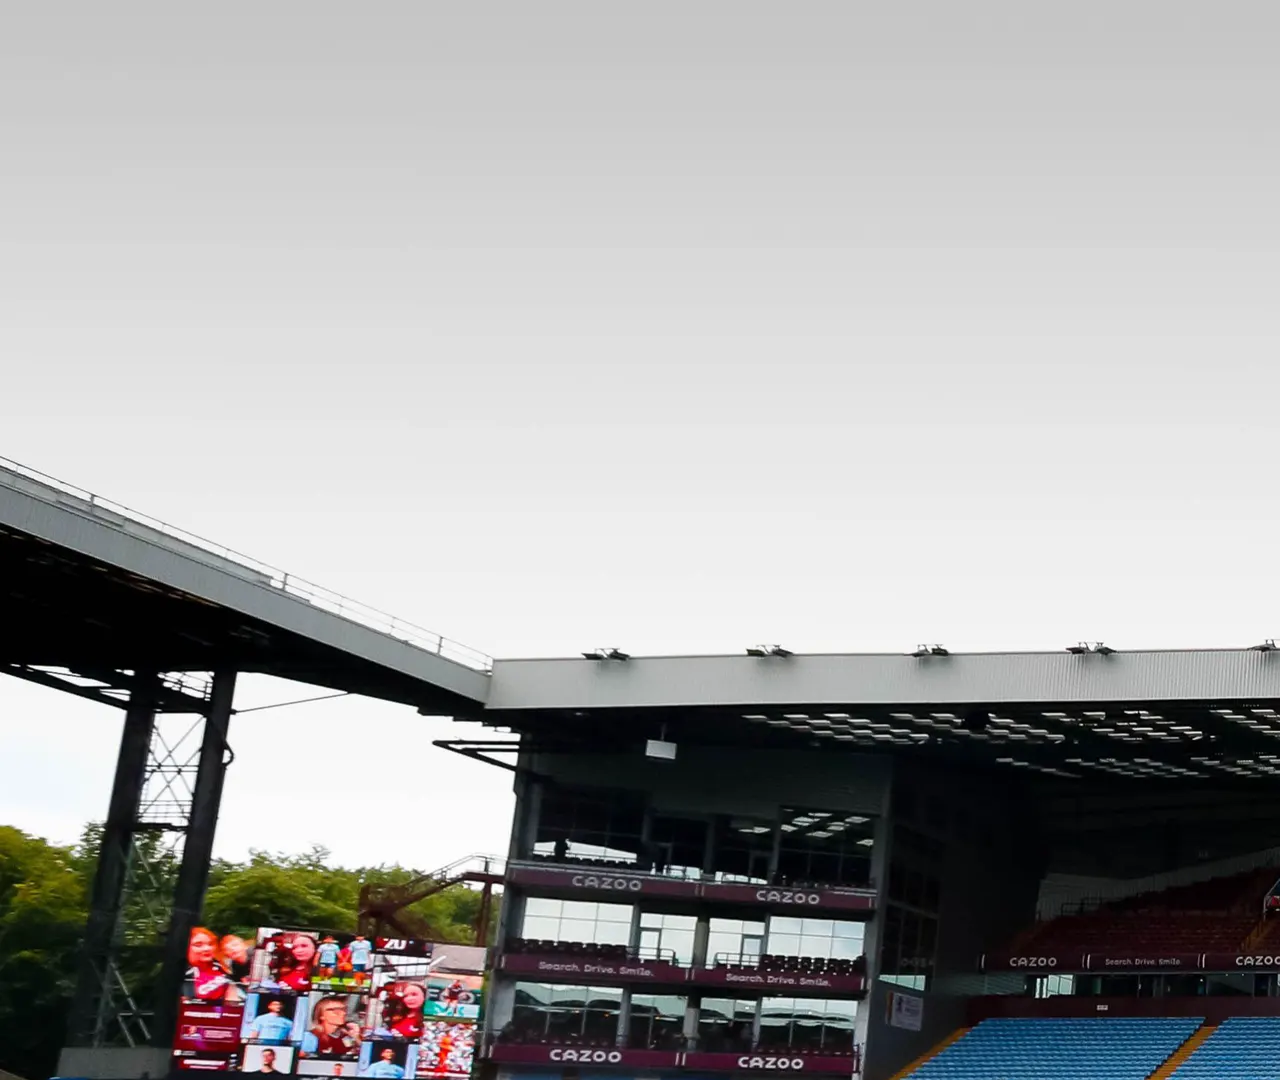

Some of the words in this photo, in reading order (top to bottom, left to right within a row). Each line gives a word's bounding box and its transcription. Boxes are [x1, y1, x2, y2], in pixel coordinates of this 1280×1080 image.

[572, 876, 642, 891] CAZOO
[756, 890, 820, 904] CAZOO
[1009, 957, 1057, 967] CAZOO
[549, 1049, 622, 1063] CAZOO
[738, 1056, 804, 1070] CAZOO
